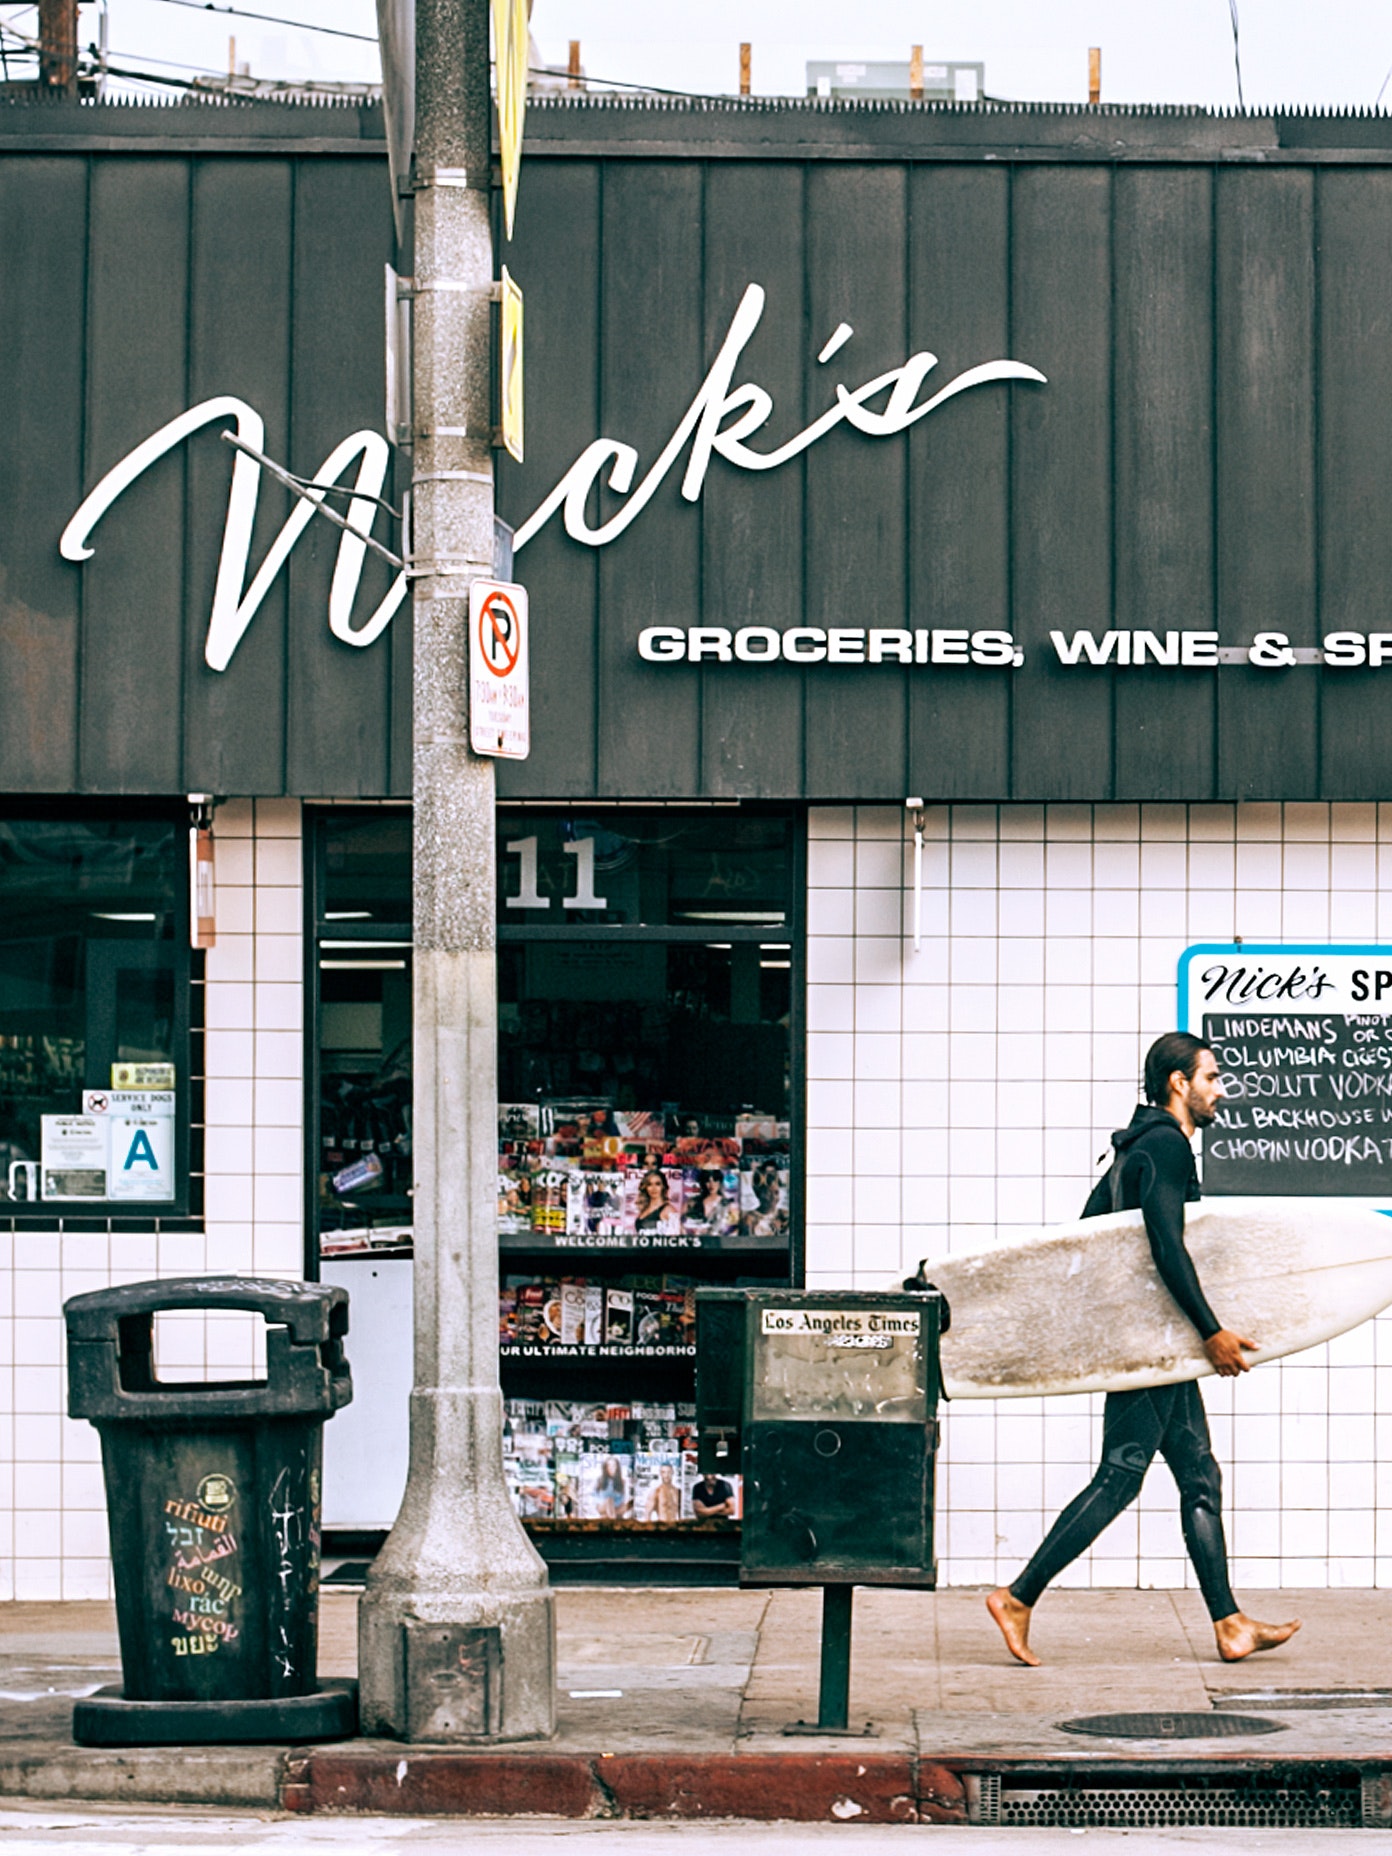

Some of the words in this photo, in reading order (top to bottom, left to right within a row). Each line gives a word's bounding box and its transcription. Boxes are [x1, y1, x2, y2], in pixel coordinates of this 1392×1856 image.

[60, 282, 1048, 672] Nck's
[637, 626, 1025, 667] GROCERIES,
[1049, 630, 1219, 666] WINE
[1247, 631, 1297, 667] &
[506, 836, 607, 909] 11
[1201, 965, 1337, 1006] Nick's
[1207, 1018, 1337, 1044] LINDEMANS
[1343, 1014, 1391, 1027] PINOT
[1353, 1029, 1380, 1043] OR
[1218, 1070, 1322, 1099] BSOLUT
[1211, 1107, 1249, 1129] ALL
[1251, 1106, 1374, 1130] BACKHOUSE
[123, 1129, 159, 1171] A
[1210, 1138, 1290, 1163] CHOPIN
[1294, 1135, 1383, 1165] VODKA
[624, 1168, 683, 1181] InSle
[555, 1236, 627, 1248] WELCOME
[632, 1236, 649, 1248] TO
[652, 1236, 702, 1248] NICK'S
[765, 1312, 794, 1330] Los
[799, 1312, 862, 1334] Angeles
[868, 1314, 920, 1332] Times
[500, 1346, 520, 1356] UR
[523, 1345, 597, 1356] ULTIMATE
[600, 1345, 697, 1356] NEIGHBORHO
[164, 1498, 228, 1533] rifiuti
[167, 1566, 206, 1595] lixo
[190, 1591, 226, 1615] rác
